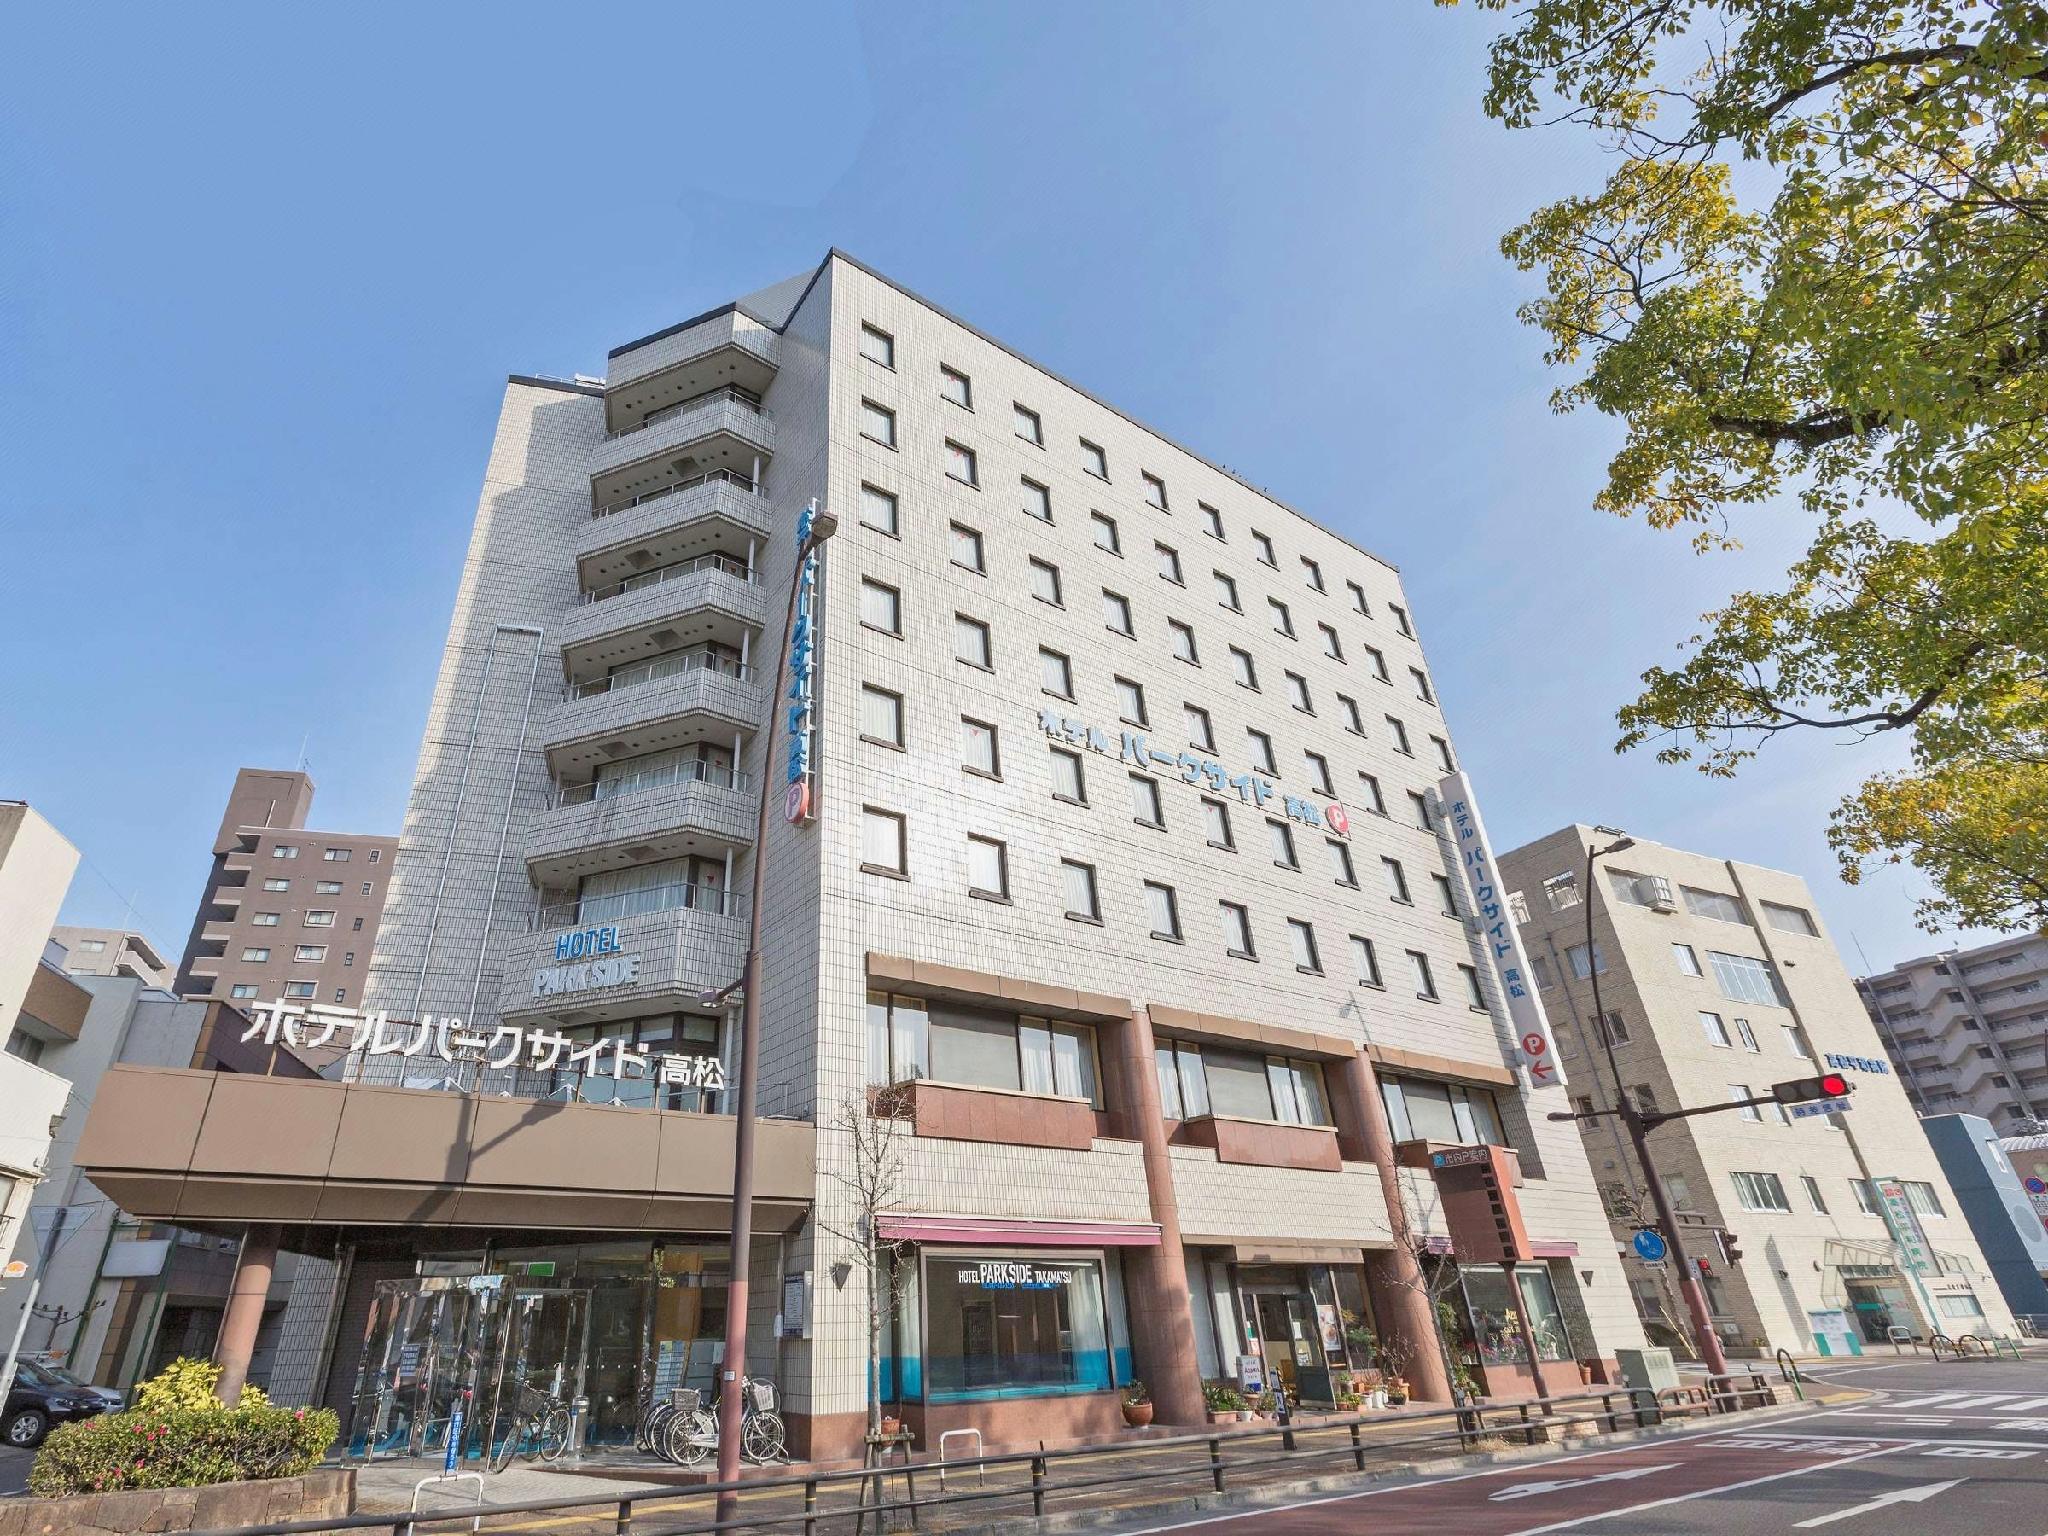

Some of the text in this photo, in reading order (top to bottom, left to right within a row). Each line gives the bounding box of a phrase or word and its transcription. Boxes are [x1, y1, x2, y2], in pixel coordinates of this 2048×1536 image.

[555, 926, 623, 961] HOTEL
[958, 1263, 1072, 1284] HOTEL PARKSIDE TAKAMATSU
